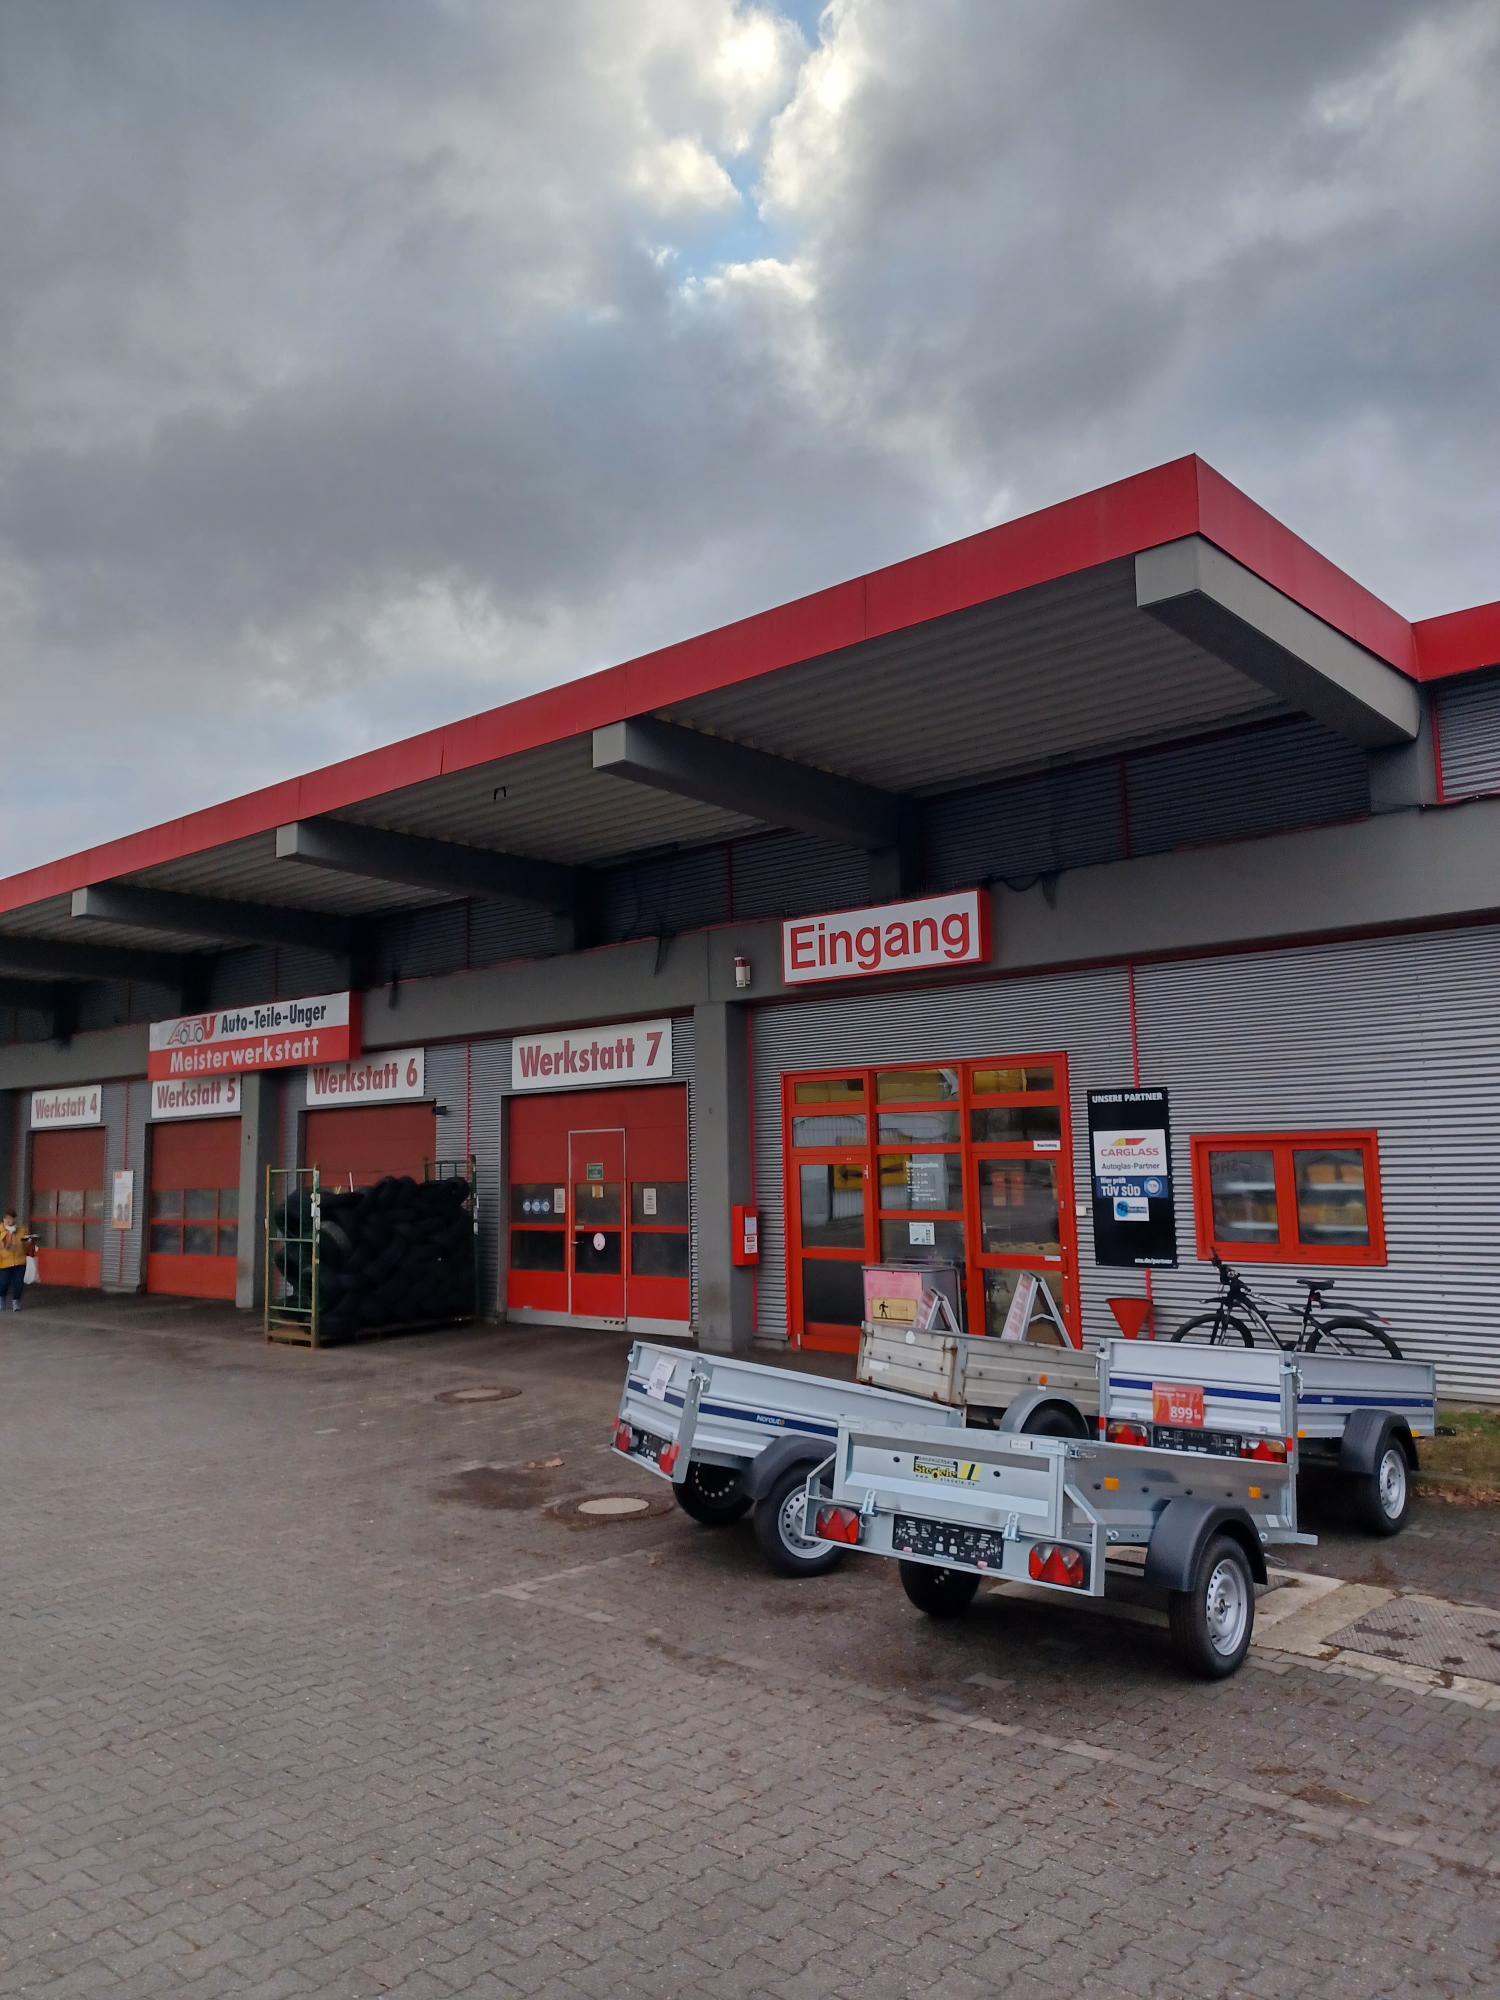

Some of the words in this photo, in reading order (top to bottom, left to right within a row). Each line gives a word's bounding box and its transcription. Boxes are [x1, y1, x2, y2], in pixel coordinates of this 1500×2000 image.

[790, 912, 971, 970] Eingang
[221, 1003, 327, 1034] Auto-Teile-Unger
[169, 1036, 319, 1073] Meisterwerkstatt
[519, 1037, 635, 1078] Werkstatt
[646, 1031, 664, 1067] 7
[312, 1062, 399, 1095] Werkstatt
[406, 1058, 418, 1088] 6
[35, 1095, 86, 1119] Werkstatt
[90, 1092, 97, 1115] 4
[156, 1079, 222, 1110] Werkstatt
[226, 1078, 236, 1104] 5
[1092, 1094, 1123, 1103] UNSERE
[1124, 1092, 1163, 1102] PARTNER
[1100, 1147, 1160, 1157] CARGLASS
[1101, 1161, 1160, 1171] Autoglas-Partner
[1101, 1184, 1119, 1197] TÜV
[1121, 1183, 1140, 1197] SÜD
[1170, 1406, 1193, 1420] 899
